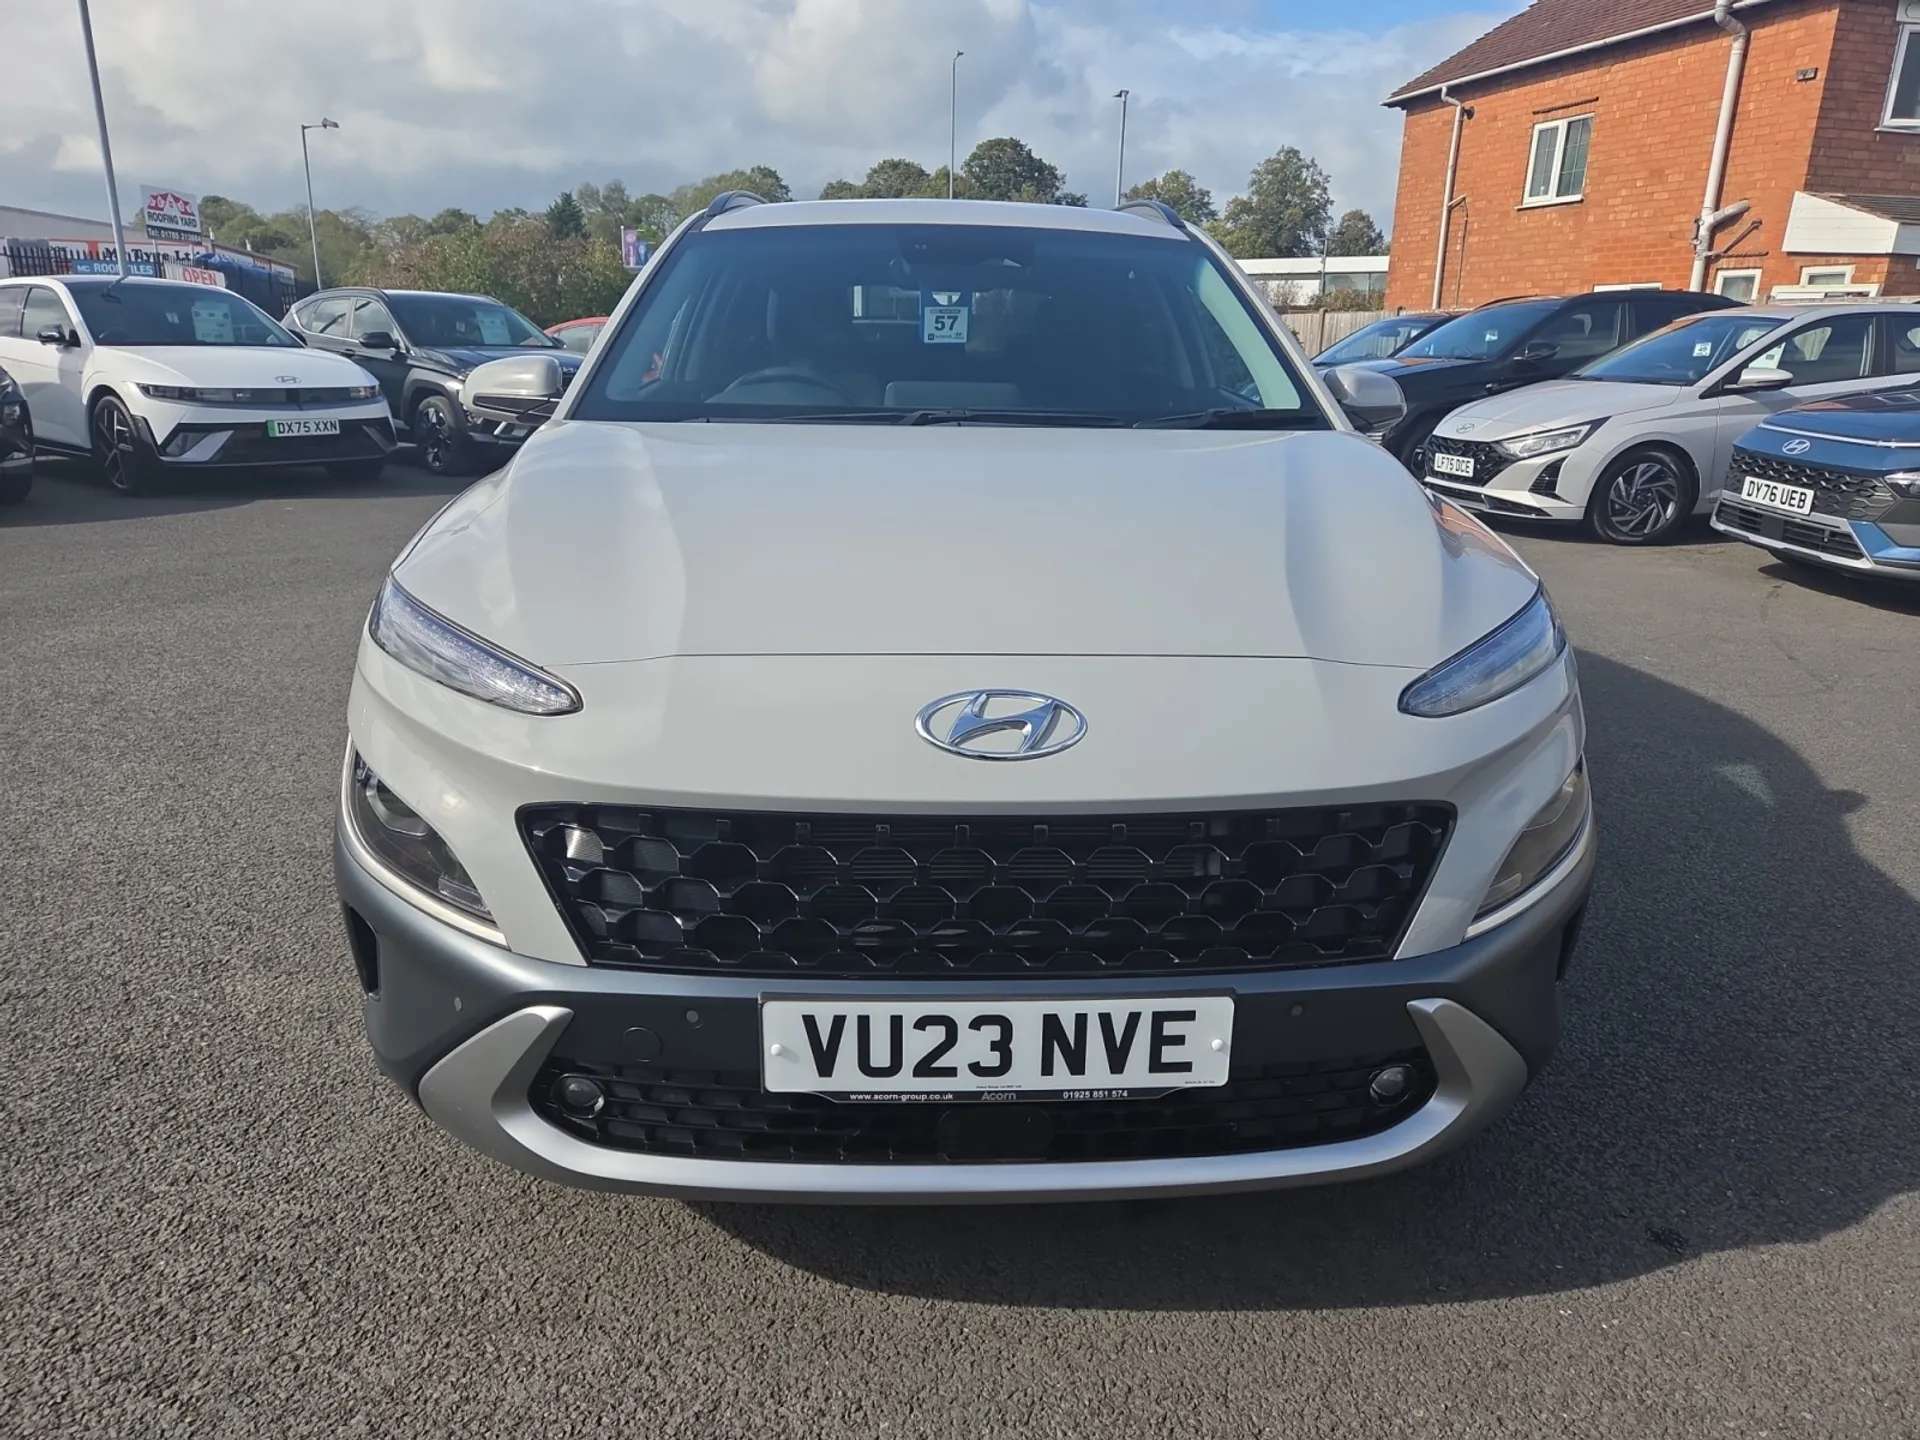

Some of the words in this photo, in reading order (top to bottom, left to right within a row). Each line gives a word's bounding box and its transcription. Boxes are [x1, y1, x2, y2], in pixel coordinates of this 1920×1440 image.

[147, 211, 179, 225] ROOFING
[179, 216, 197, 228] YARD
[183, 268, 217, 285] OPEN
[934, 315, 959, 331] 57
[277, 421, 311, 434] DX75
[313, 420, 337, 432] XXN
[1747, 480, 1778, 502] DY76
[1780, 487, 1807, 509] UEB
[801, 1014, 1013, 1078] VU23
[1040, 1010, 1197, 1077] NVE
[849, 1093, 953, 1102] www.acorn-group.co.uk
[981, 1090, 1017, 1101] Acorn
[1063, 1090, 1091, 1099] 01925
[1092, 1090, 1108, 1098] 851
[1111, 1089, 1128, 1098] 574
